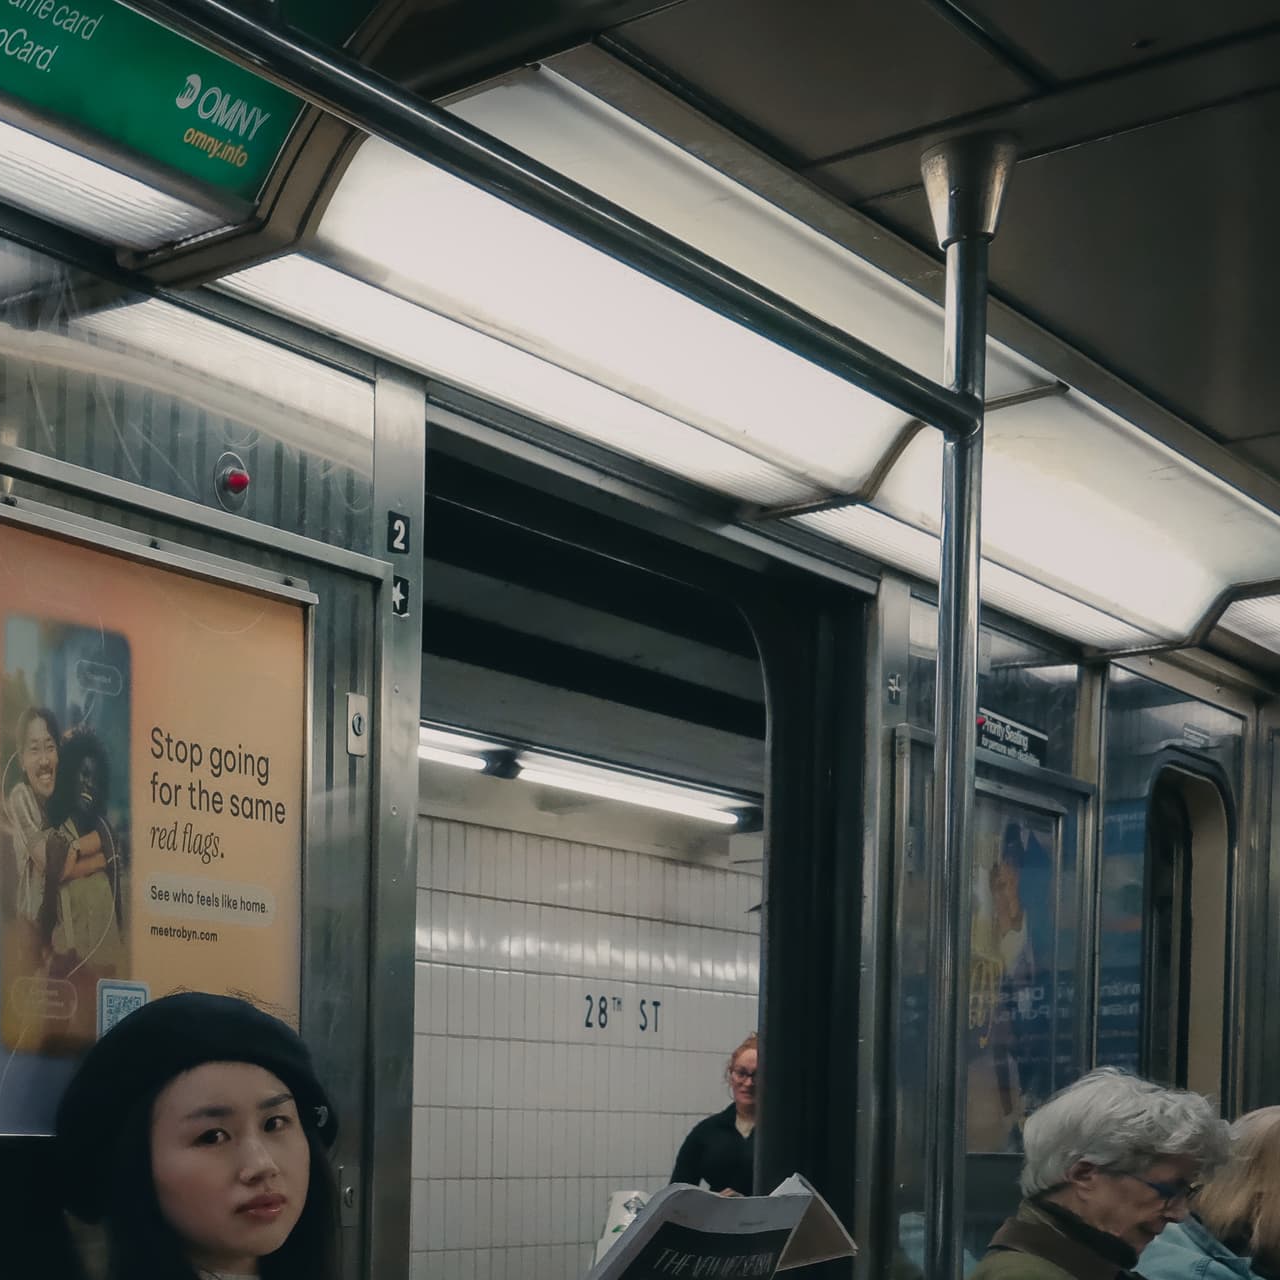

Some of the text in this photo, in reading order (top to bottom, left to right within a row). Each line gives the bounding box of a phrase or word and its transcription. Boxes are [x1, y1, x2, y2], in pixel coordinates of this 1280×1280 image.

[52, 5, 104, 40] card
[197, 86, 271, 141] OMNY
[183, 127, 248, 167] omny.info
[392, 519, 406, 550] 2
[150, 726, 270, 786] Stop going
[150, 771, 287, 824] for the same
[149, 820, 225, 865] red flags.
[150, 885, 269, 914] See who feels like home.
[150, 923, 218, 943] meetrobyn.com
[584, 994, 661, 1033] 28TH ST
